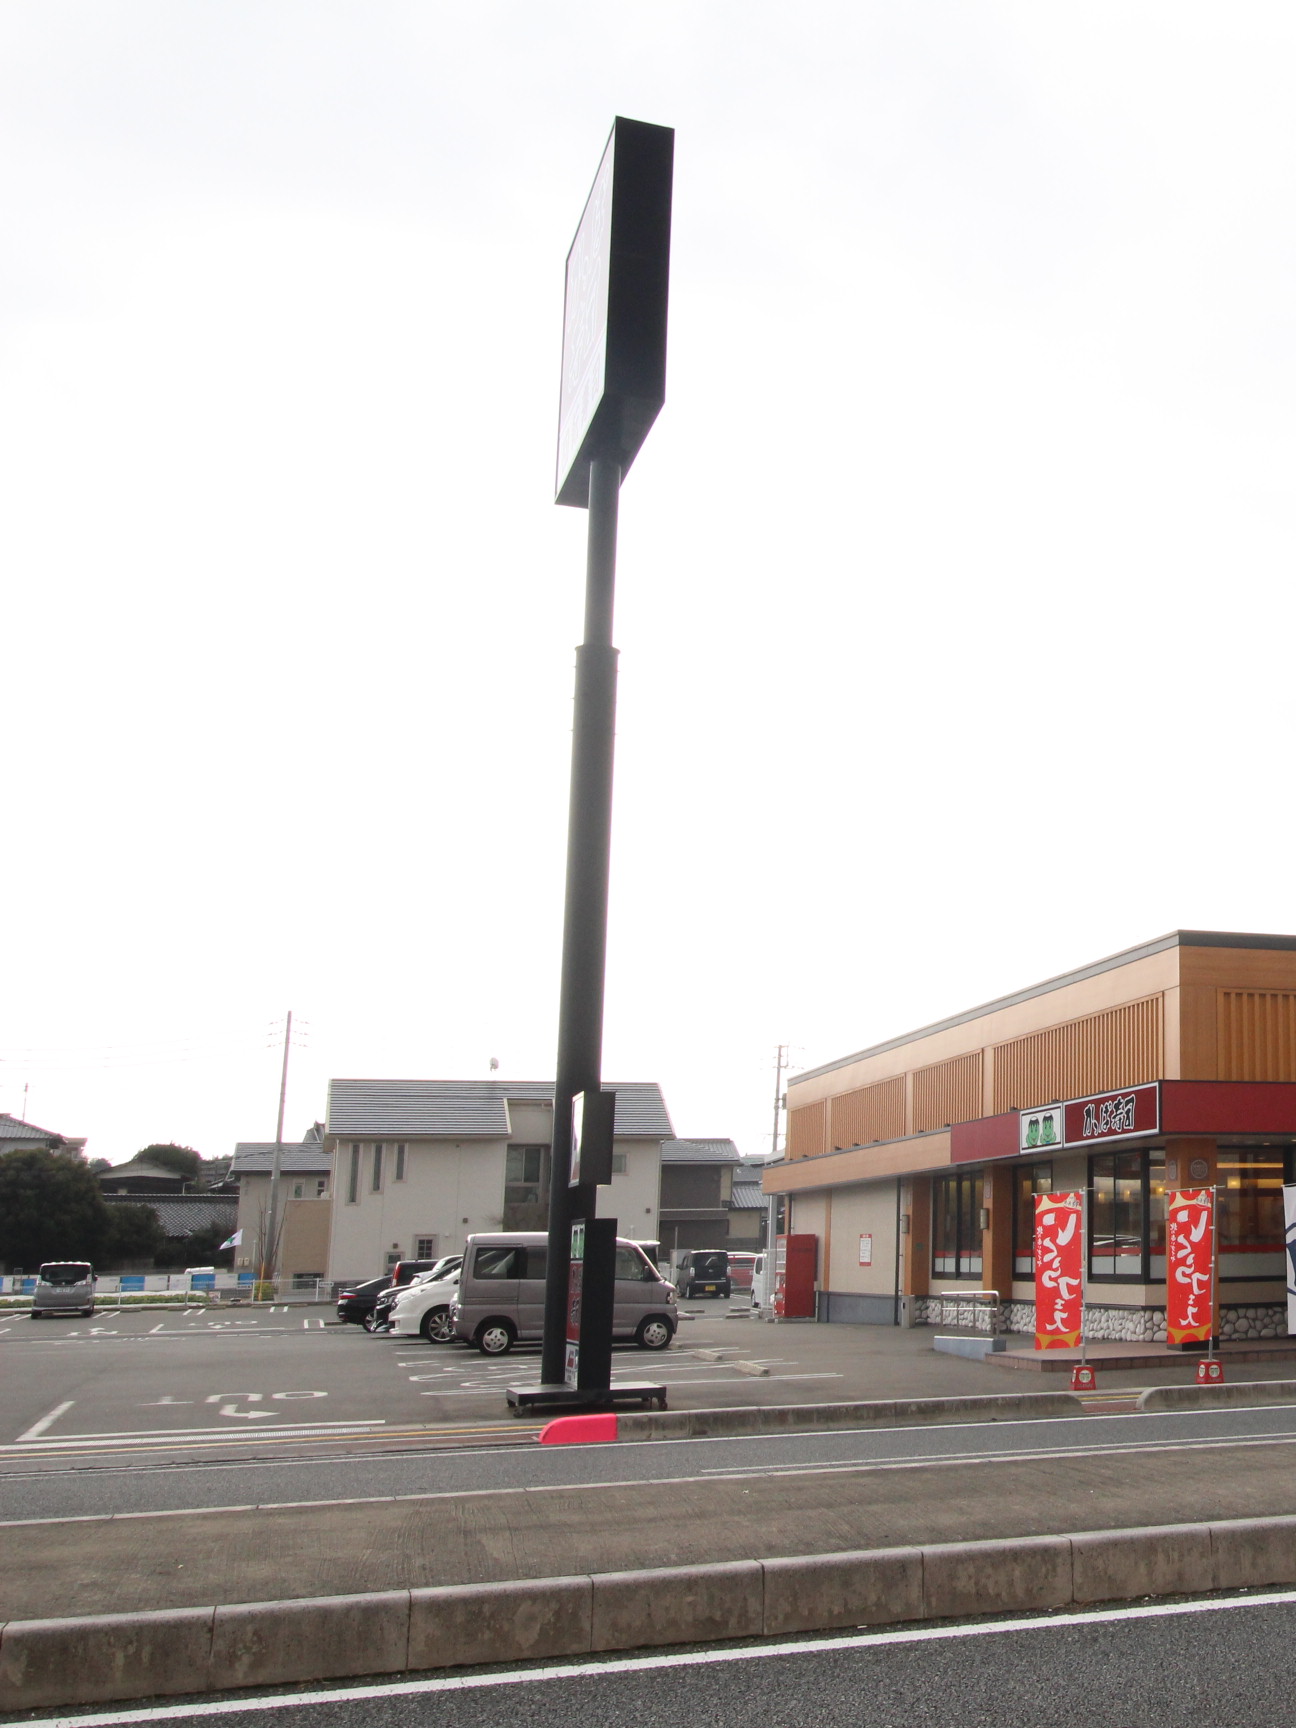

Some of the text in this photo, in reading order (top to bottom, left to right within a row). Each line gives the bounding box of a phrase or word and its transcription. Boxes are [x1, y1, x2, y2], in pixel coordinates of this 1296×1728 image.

[1083, 1094, 1136, 1137] かっぱ寿司
